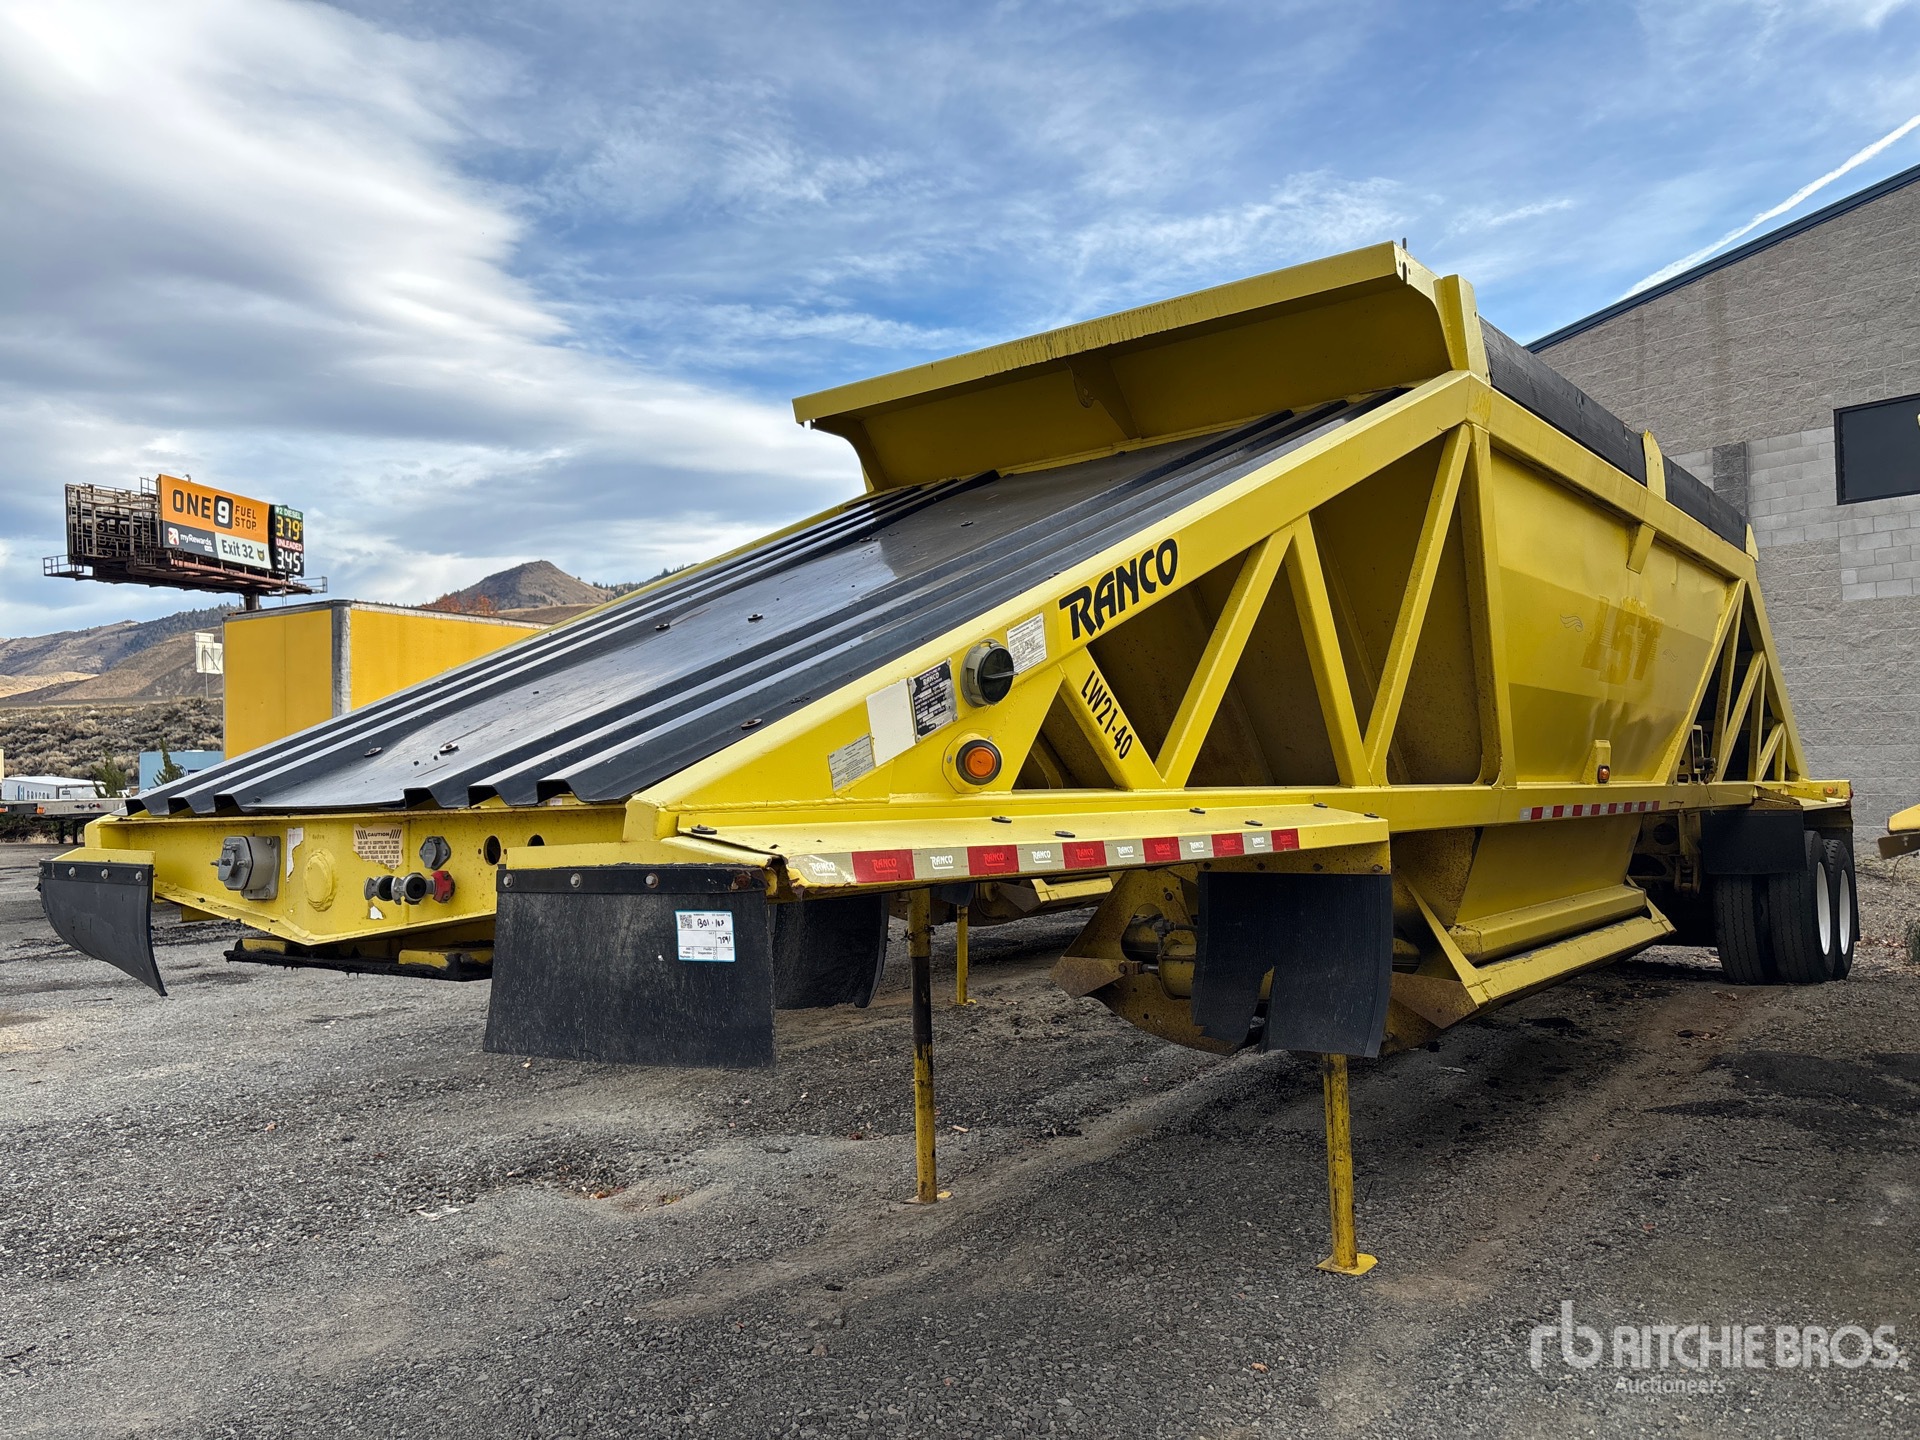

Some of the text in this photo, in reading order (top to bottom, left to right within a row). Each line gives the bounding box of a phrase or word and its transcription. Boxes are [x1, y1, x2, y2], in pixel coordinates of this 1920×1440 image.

[173, 489, 230, 524] ONE 9
[235, 505, 257, 519] FUEL
[284, 508, 302, 520] DIESEL
[180, 534, 213, 546] myRewards
[276, 537, 303, 552] UNLEADED
[221, 539, 254, 560] Exit 32
[1059, 538, 1178, 640] RANCO
[1081, 669, 1133, 760] LW21-40
[1032, 850, 1051, 860] RANCO
[1076, 848, 1094, 858] RANCO
[1117, 845, 1134, 855] RANCO
[872, 857, 898, 870] RANCO
[930, 855, 954, 866] RANCO
[983, 852, 1005, 863] RANCO
[809, 861, 836, 873] RANCO
